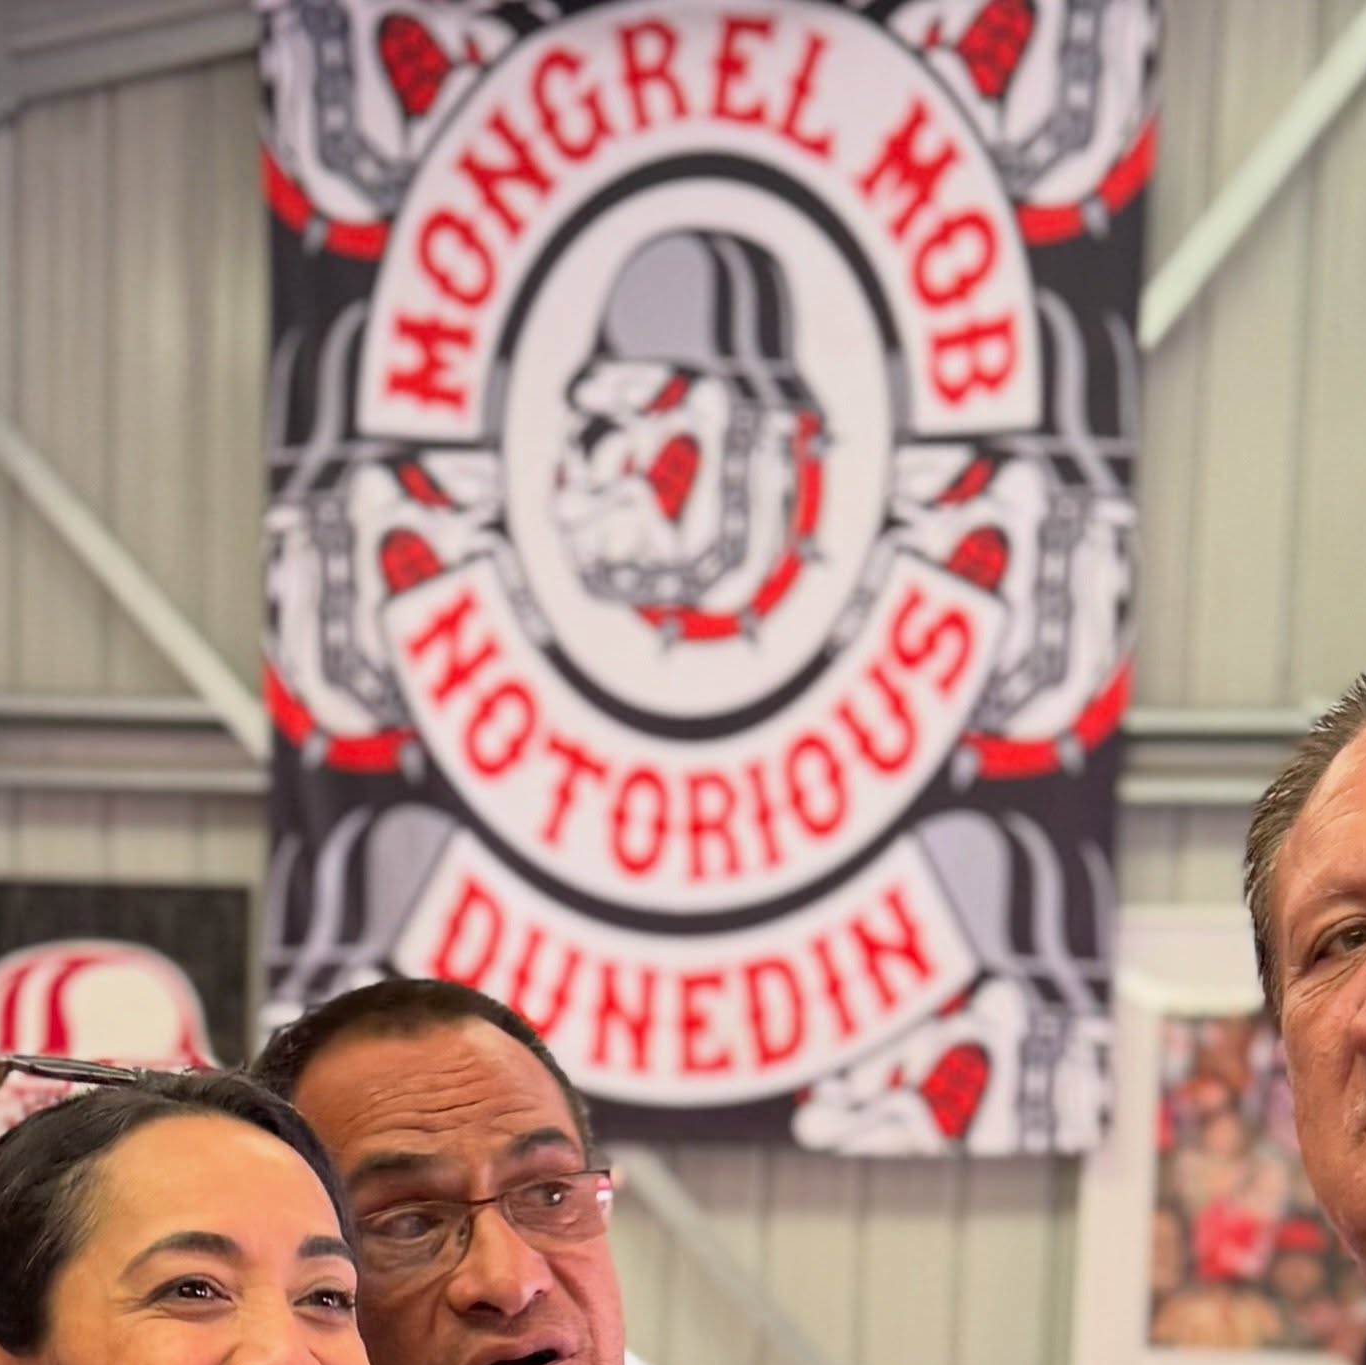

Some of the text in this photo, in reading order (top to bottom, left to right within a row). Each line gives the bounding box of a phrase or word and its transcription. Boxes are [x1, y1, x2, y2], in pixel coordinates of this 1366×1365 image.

[384, 15, 1022, 420] MONGREL MOB
[404, 583, 979, 884] NOTORIOUS
[429, 873, 937, 1079] DUNEDIN
